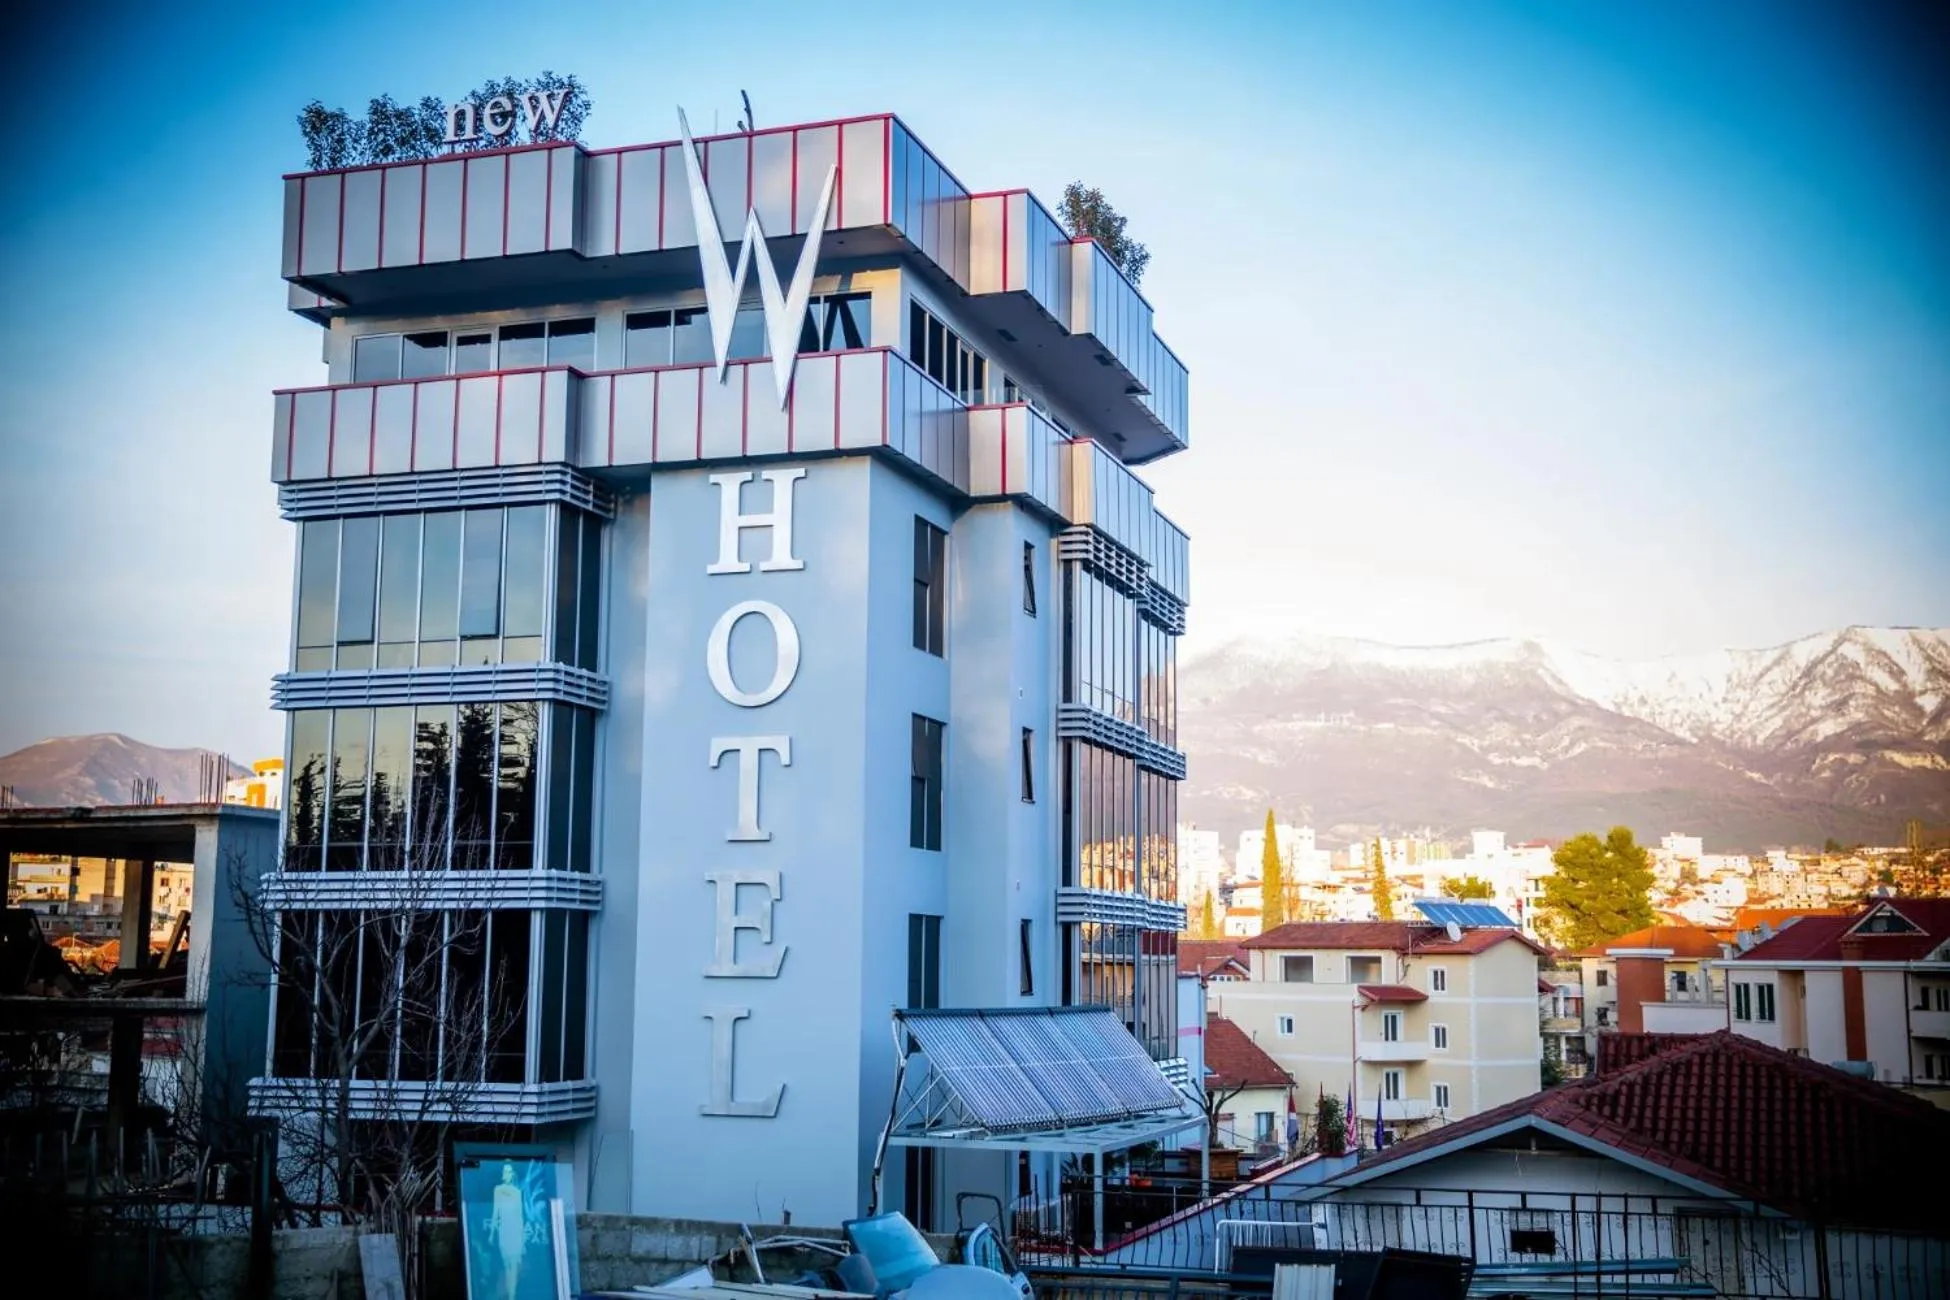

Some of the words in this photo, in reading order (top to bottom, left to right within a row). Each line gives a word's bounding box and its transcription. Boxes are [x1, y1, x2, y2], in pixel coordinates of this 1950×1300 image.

[444, 88, 572, 142] new
[677, 105, 838, 412] W
[700, 467, 807, 1118] HOTEL
